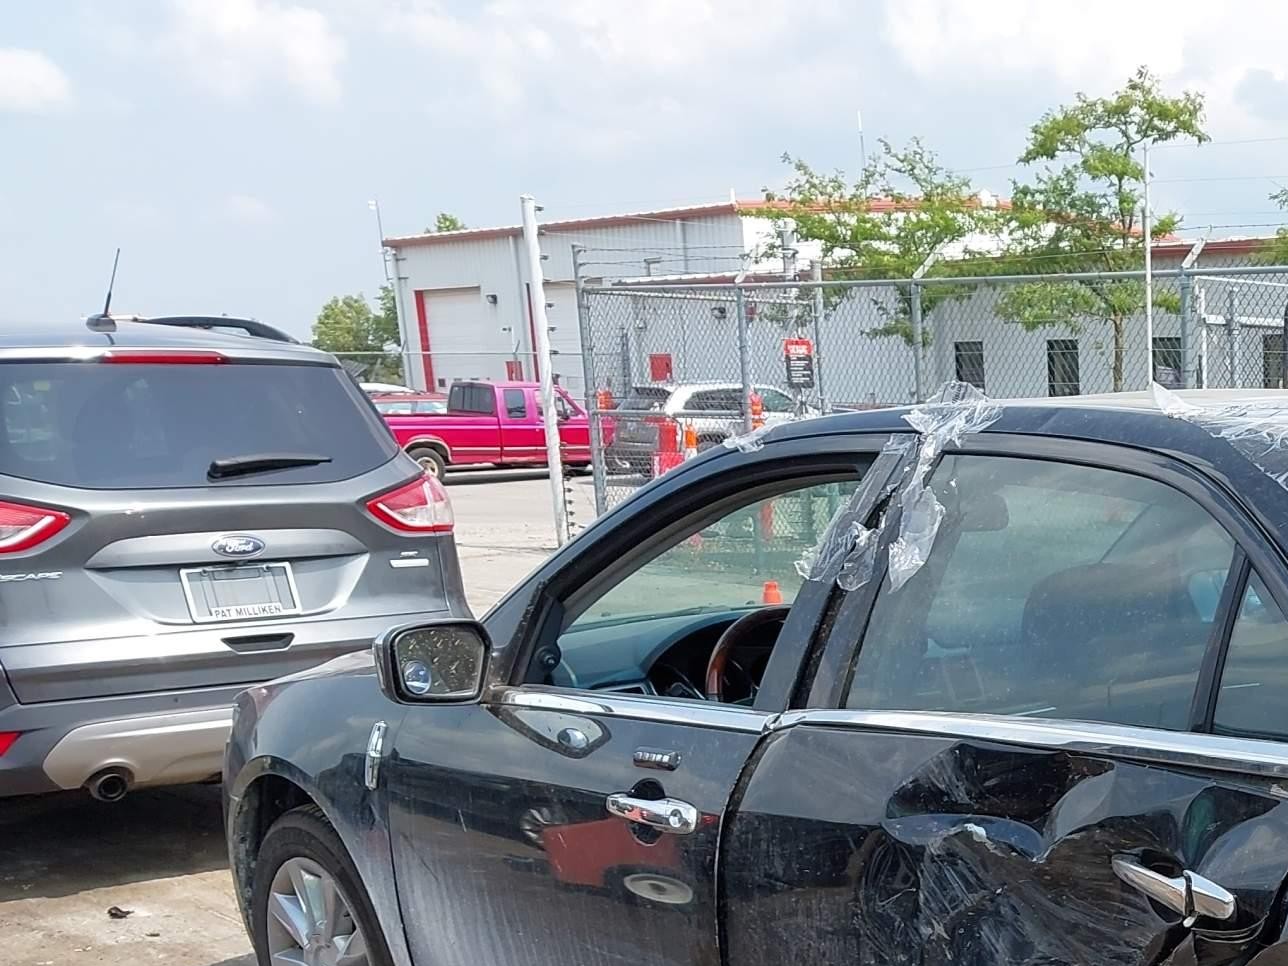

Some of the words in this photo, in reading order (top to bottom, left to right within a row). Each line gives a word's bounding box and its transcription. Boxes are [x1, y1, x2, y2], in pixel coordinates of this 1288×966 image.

[0, 571, 63, 581] SCAPE
[214, 608, 231, 618] PAT
[235, 604, 282, 617] MILLIKEN
